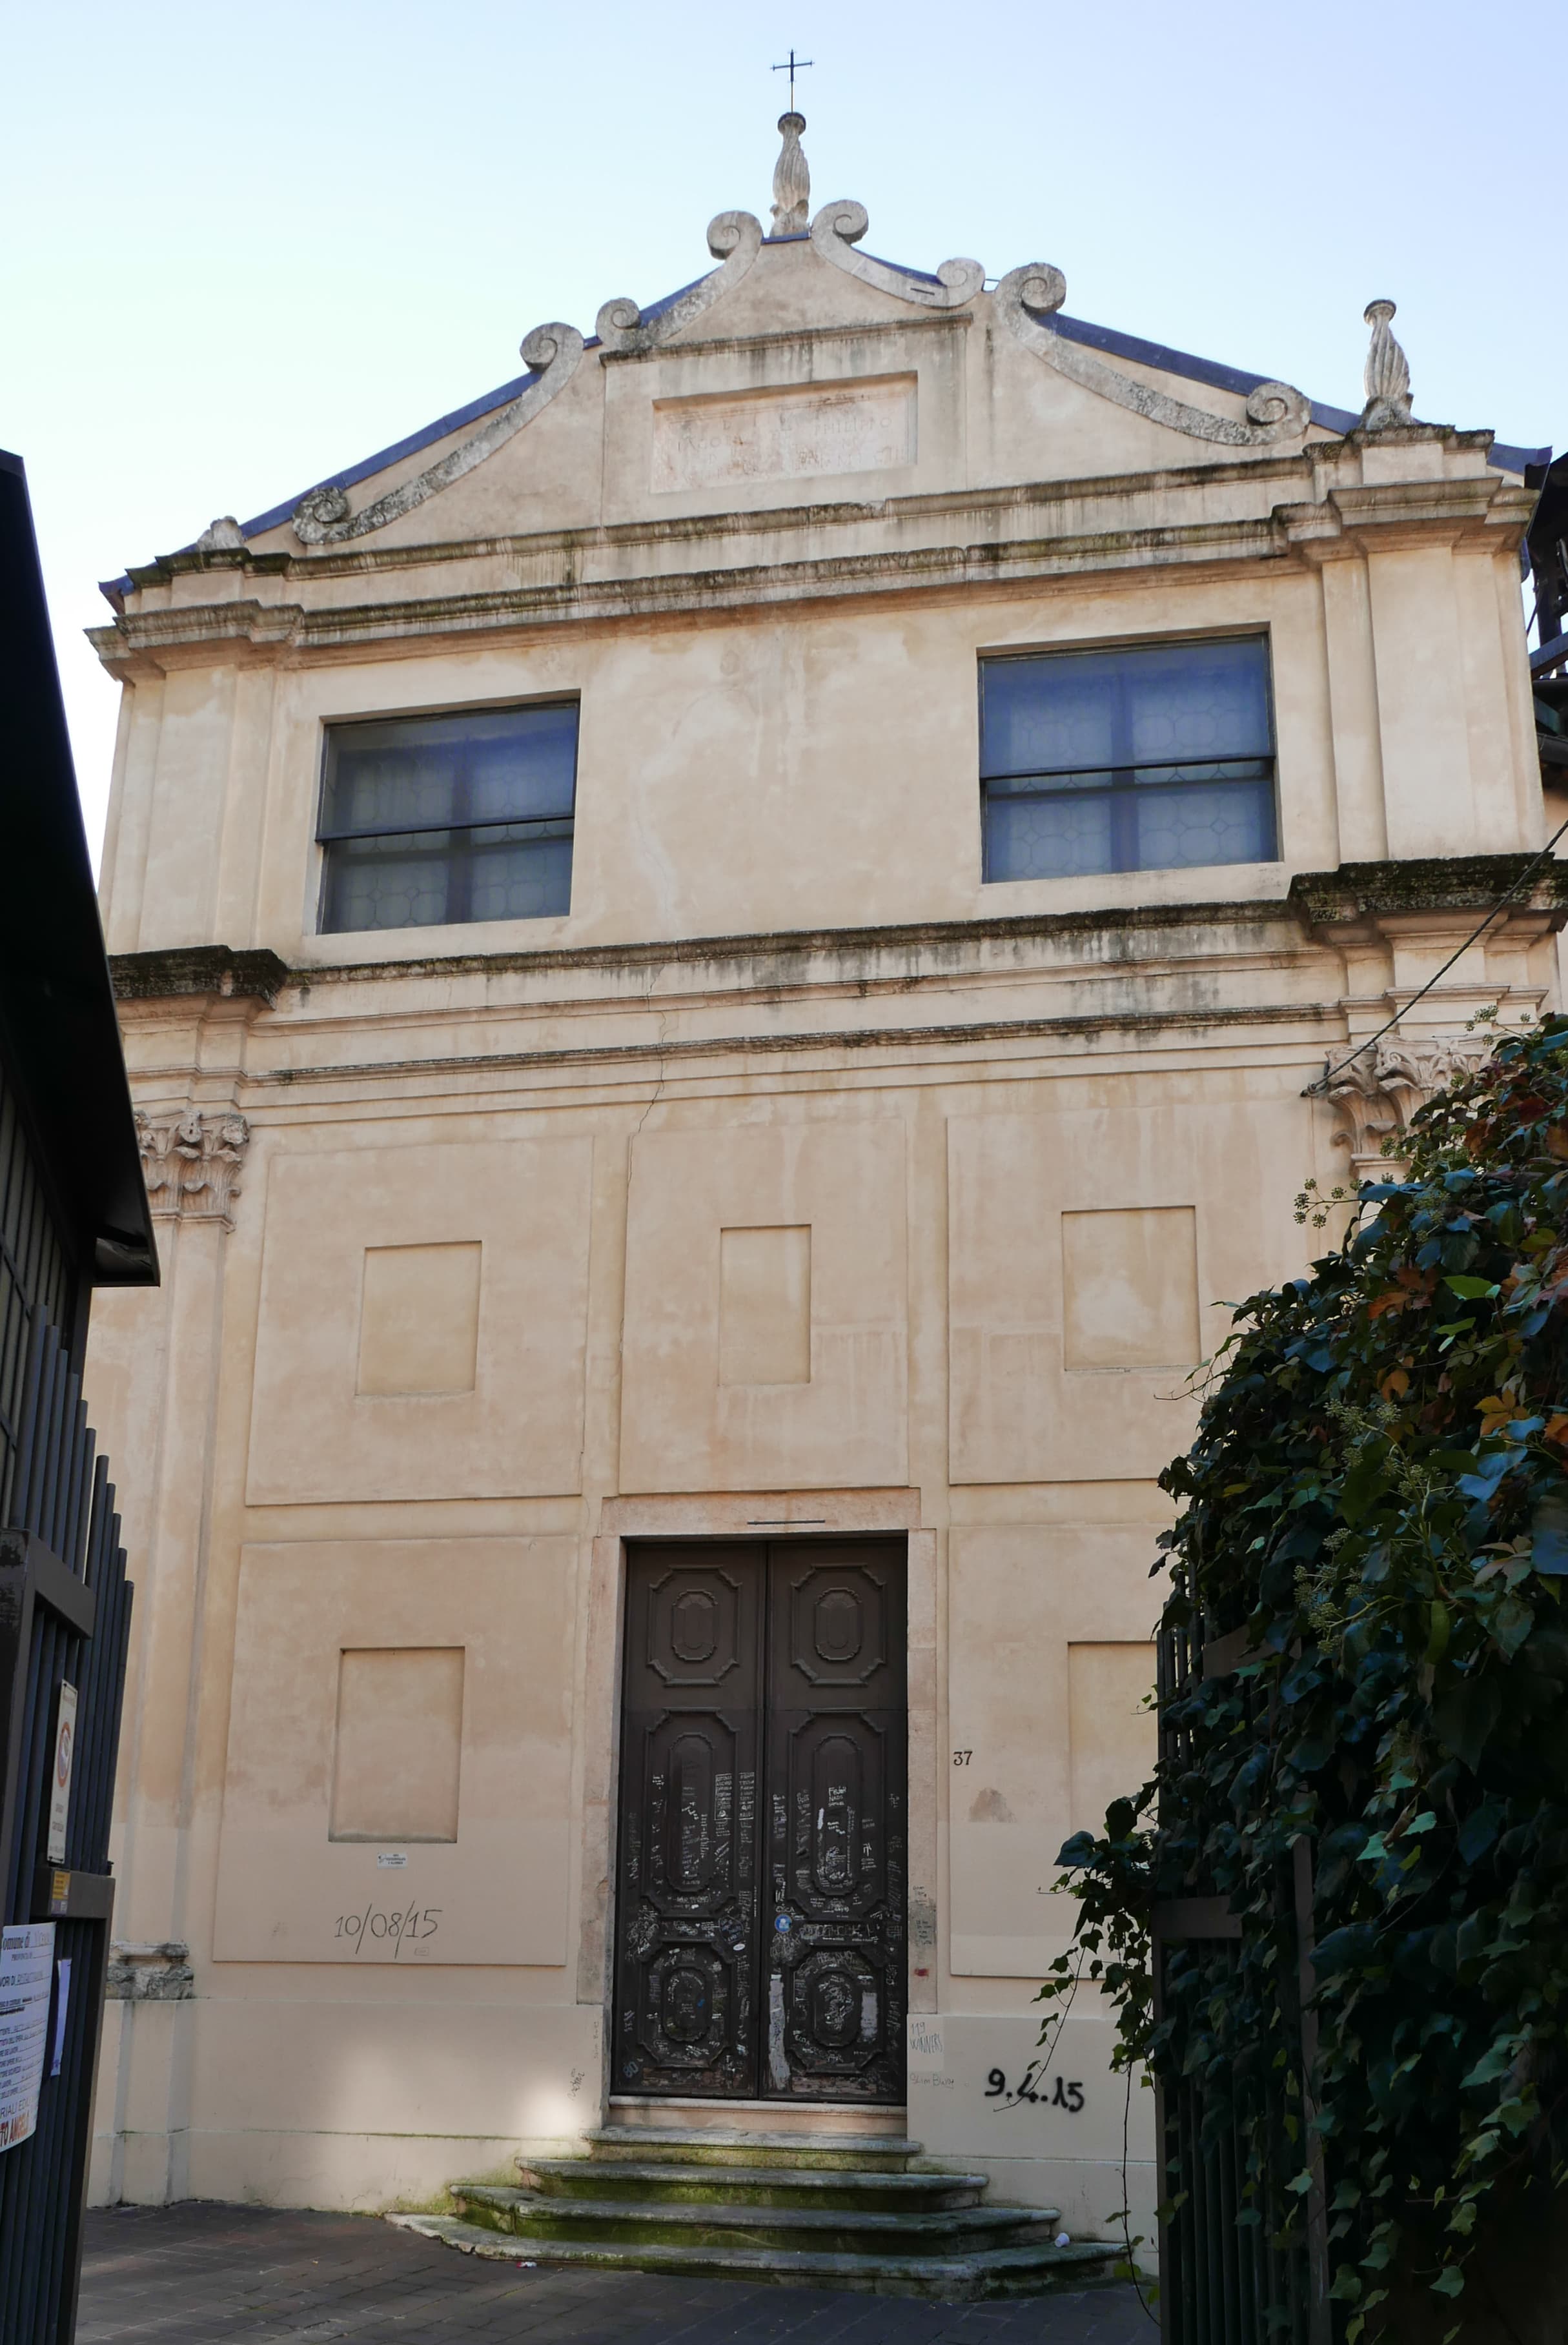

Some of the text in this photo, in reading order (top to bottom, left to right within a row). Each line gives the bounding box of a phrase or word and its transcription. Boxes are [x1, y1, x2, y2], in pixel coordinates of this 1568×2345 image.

[953, 1751, 973, 1766] 37
[334, 1900, 443, 1959] 10/08/15
[984, 2068, 1085, 2113] 9.4.15
